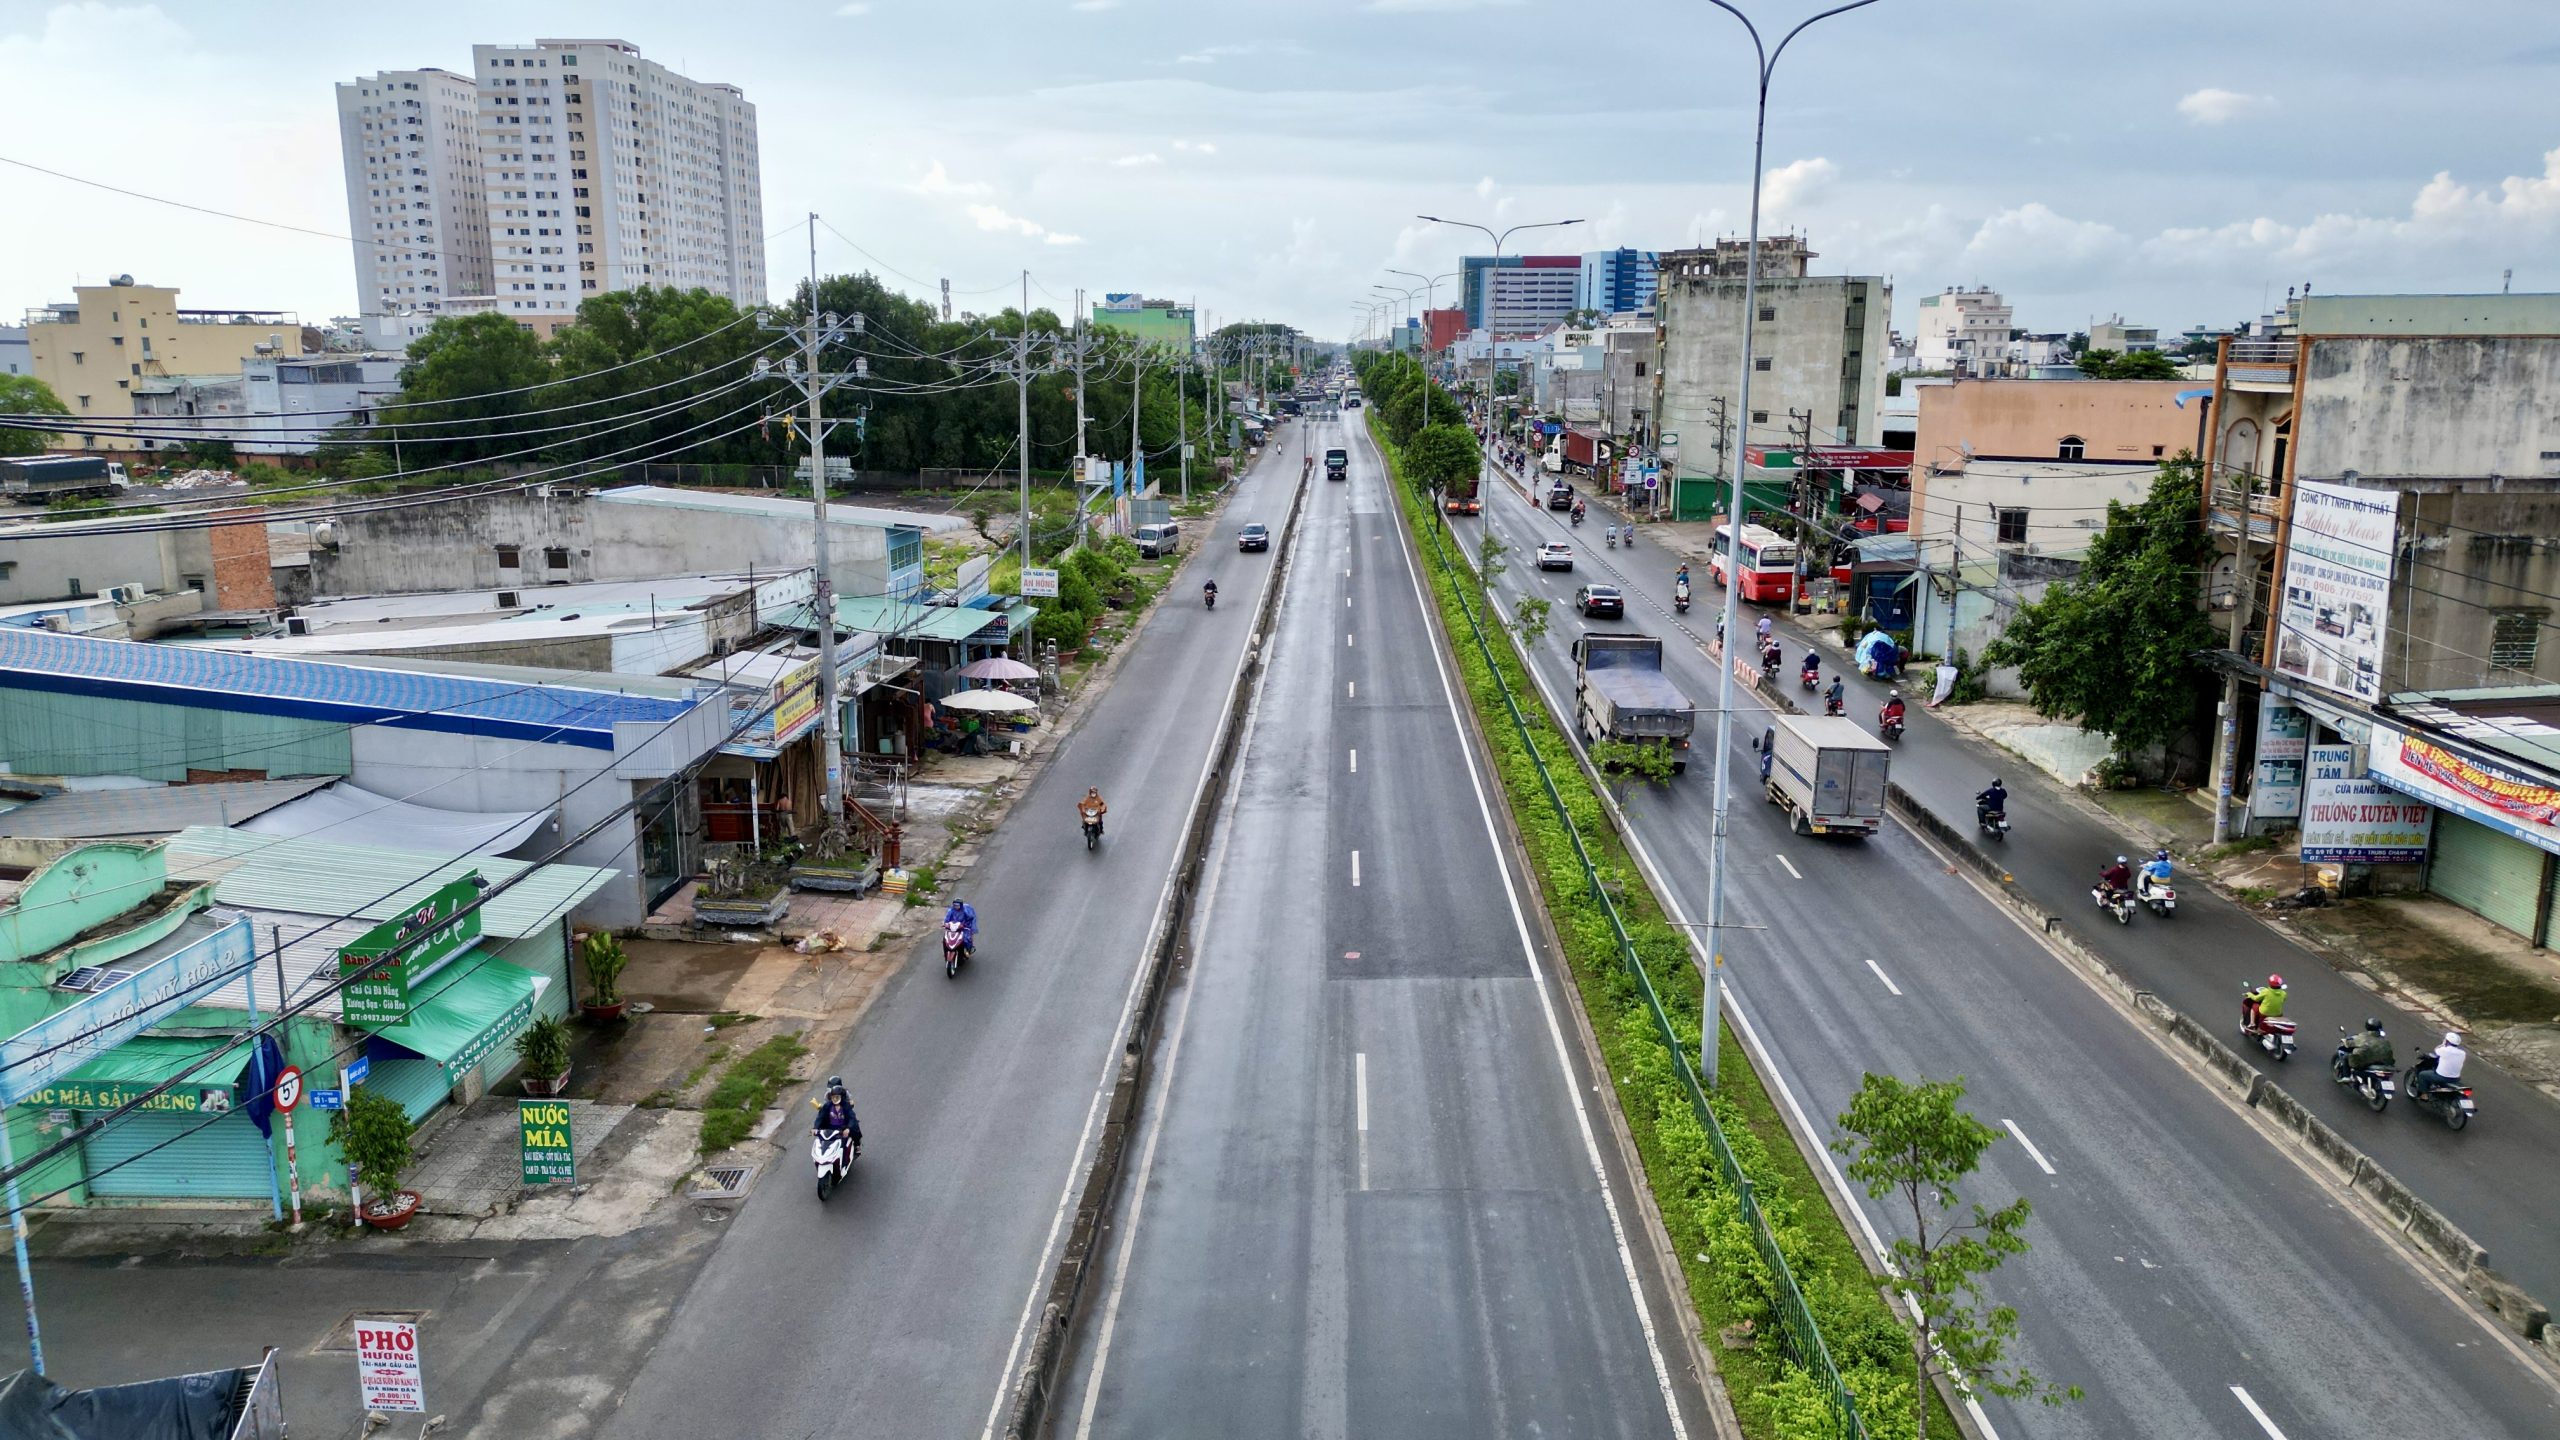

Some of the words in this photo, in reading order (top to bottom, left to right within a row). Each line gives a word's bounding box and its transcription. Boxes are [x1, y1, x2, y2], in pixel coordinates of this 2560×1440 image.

[2320, 494, 2329, 506] TY
[2300, 510, 2339, 542] Happy
[2343, 517, 2383, 542] House
[2312, 750, 2349, 762] TRUNG
[2317, 765, 2341, 779] TÂM
[2311, 801, 2356, 822] THƯƠNG
[2359, 800, 2399, 822] XUYÊN
[2402, 800, 2428, 828] VIỆT
[224, 949, 236, 968] 2
[364, 985, 372, 995] Cá
[366, 998, 378, 1010] Sụn
[382, 999, 394, 1010] Giò
[394, 1000, 406, 1010] Heo
[60, 1086, 94, 1106] MÍA
[521, 1104, 568, 1125] NƯỚC
[525, 1126, 568, 1147] MÍA
[357, 1325, 414, 1351] PHỞ
[362, 1351, 414, 1361] HƯƠNG
